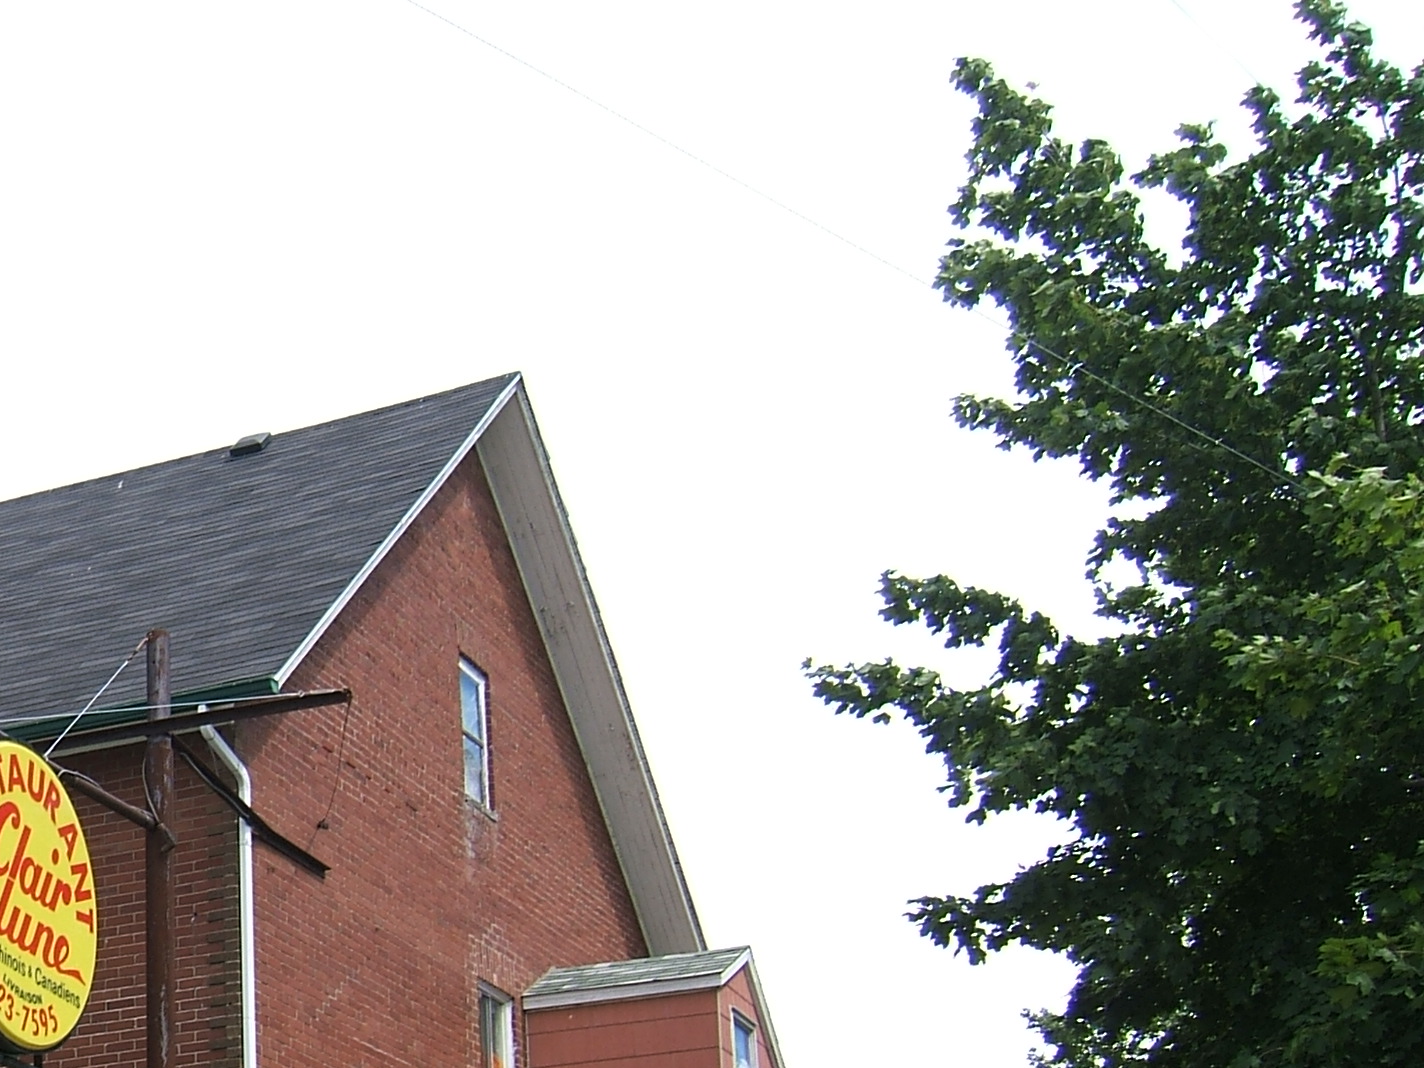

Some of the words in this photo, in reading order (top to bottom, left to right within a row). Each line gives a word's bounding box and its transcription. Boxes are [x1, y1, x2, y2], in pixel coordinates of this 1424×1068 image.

[2, 973, 43, 1005] LIVRAISON
[28, 965, 33, 979] &
[34, 967, 81, 1010] Canadiens
